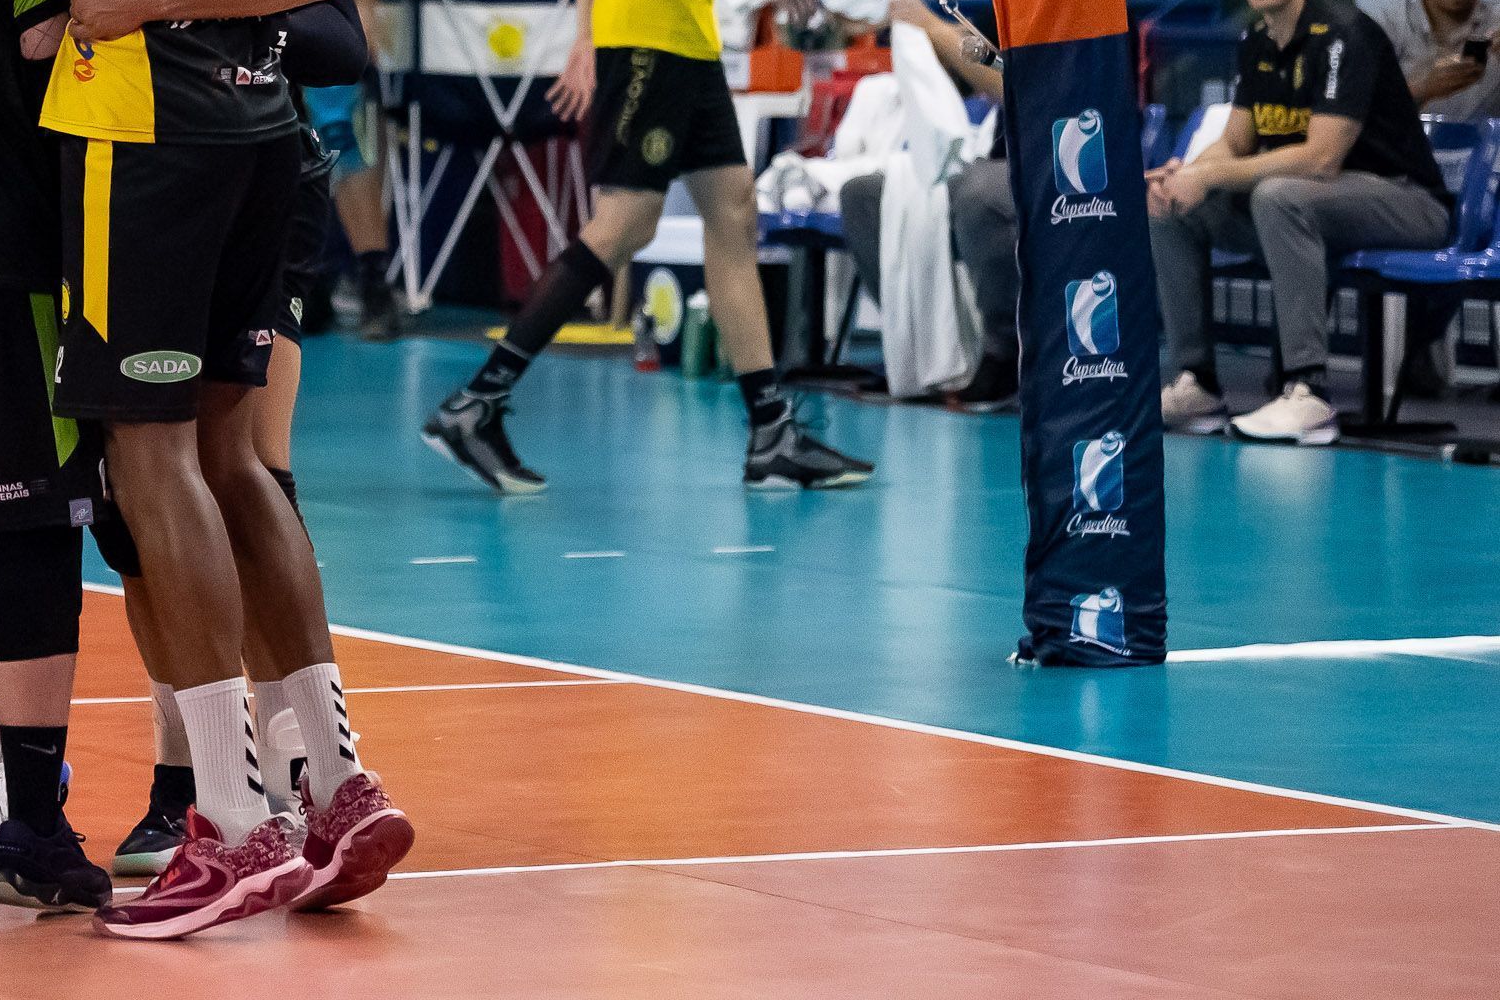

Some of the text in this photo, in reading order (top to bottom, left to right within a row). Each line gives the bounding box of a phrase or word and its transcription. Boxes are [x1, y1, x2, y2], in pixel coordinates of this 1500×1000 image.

[1051, 194, 1117, 225] Superliga
[133, 360, 192, 374] SADA
[1062, 355, 1128, 386] Superliga
